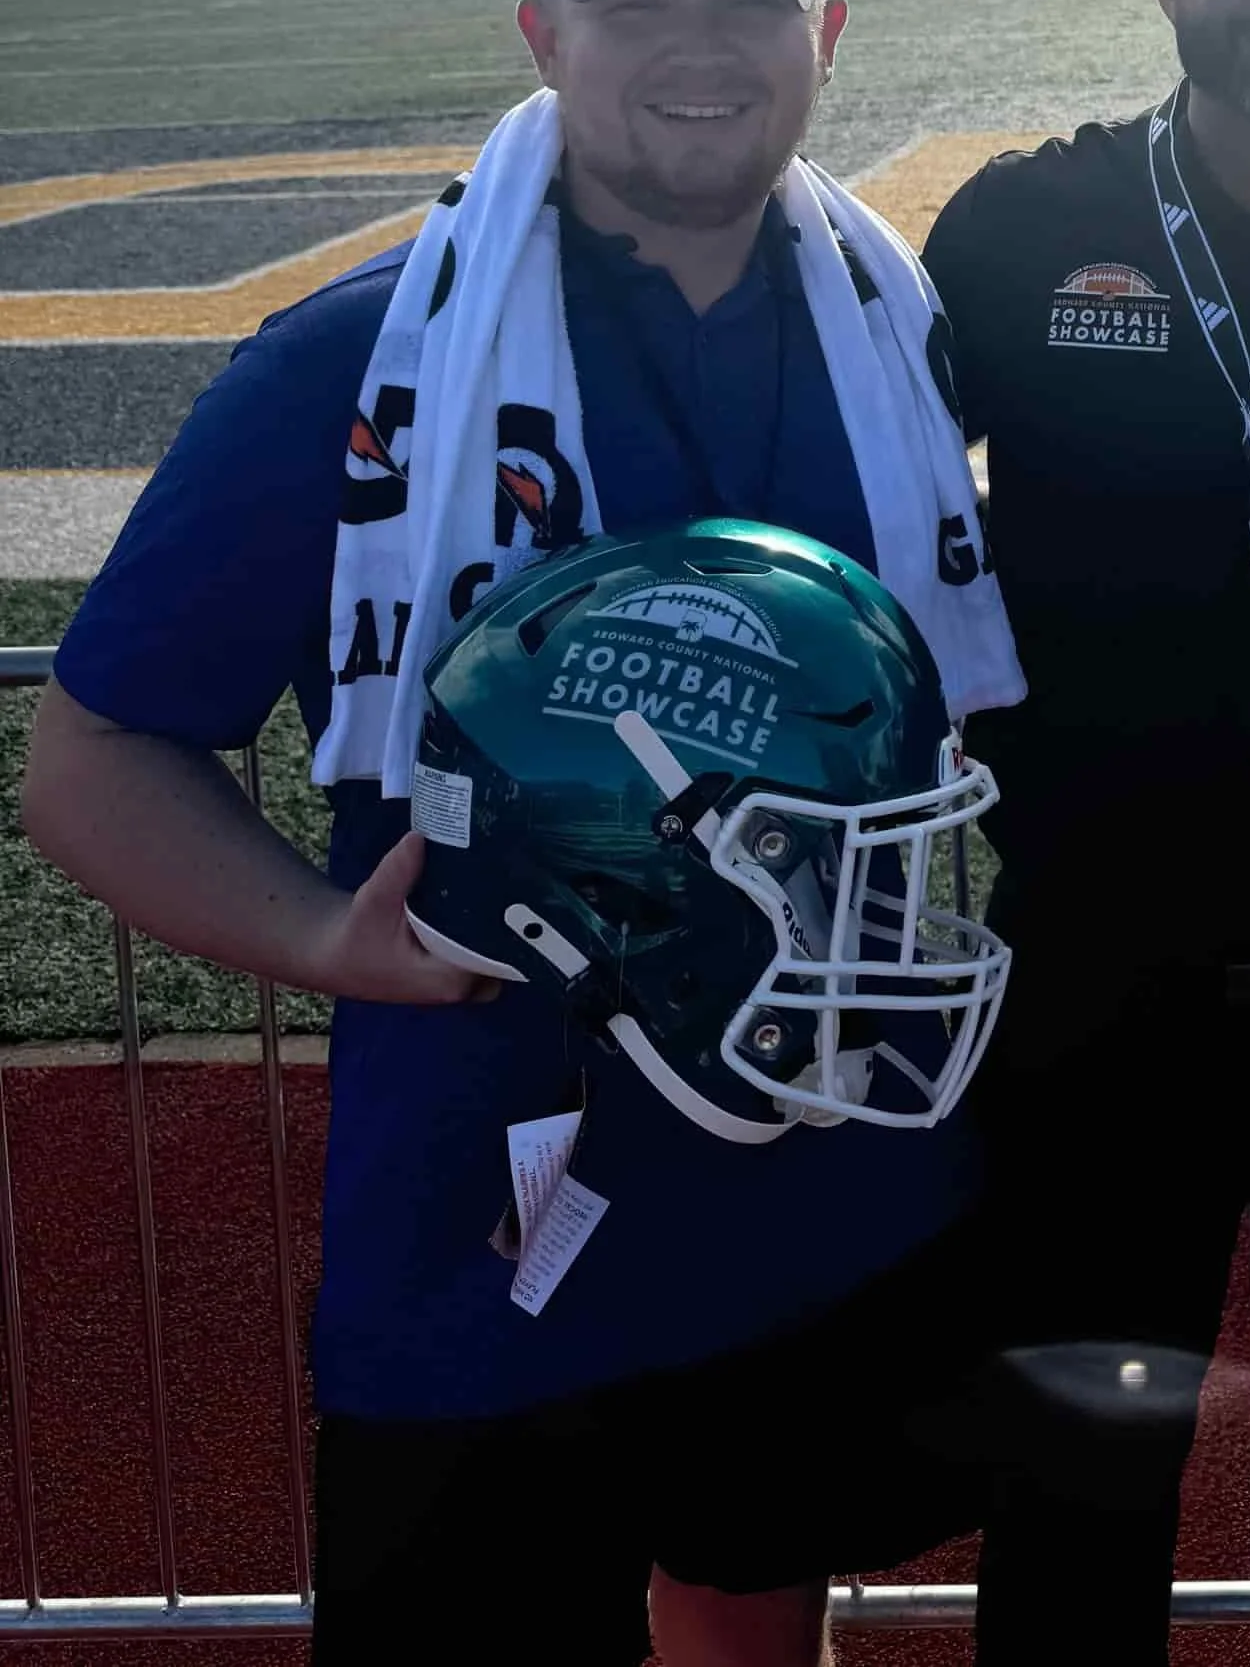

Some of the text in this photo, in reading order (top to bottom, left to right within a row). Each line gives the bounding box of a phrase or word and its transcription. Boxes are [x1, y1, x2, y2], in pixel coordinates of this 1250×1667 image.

[1048, 325, 1170, 346] SHOWCASE
[1050, 308, 1171, 329] FOOTBALL
[560, 641, 779, 723] FOOTBALL
[592, 629, 777, 685] BROWARD COUNTY NATIONAL
[548, 675, 772, 755] SHOWCASE
